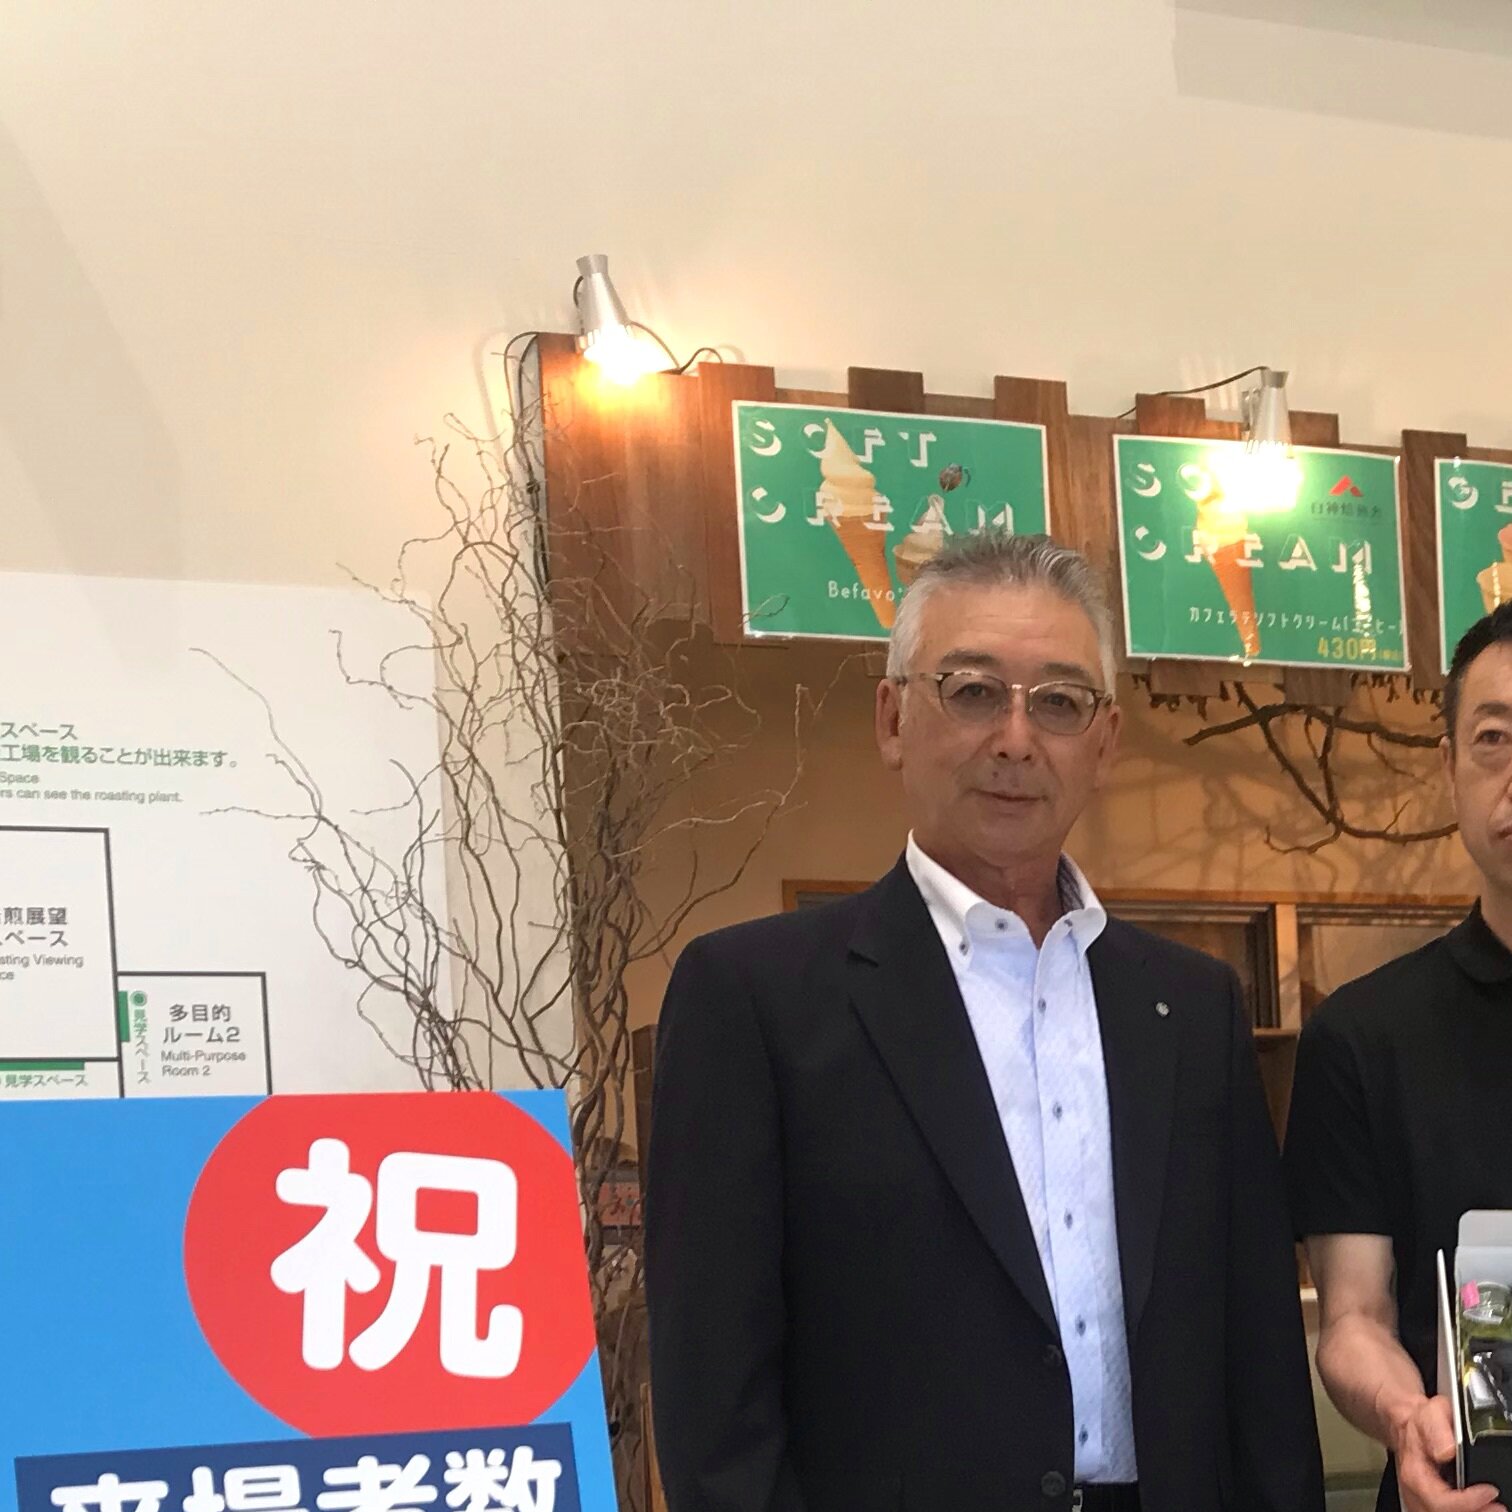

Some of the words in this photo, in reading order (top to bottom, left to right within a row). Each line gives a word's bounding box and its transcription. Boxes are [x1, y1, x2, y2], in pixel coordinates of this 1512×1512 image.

[1130, 525, 1372, 574] CREAM
[828, 579, 903, 602] Befavo
[0, 743, 237, 768] 工場を観ることが出来ます。
[0, 771, 39, 786] Space
[16, 788, 40, 799] can
[44, 789, 67, 800] see
[70, 788, 91, 800] the
[94, 789, 145, 804] roasting
[0, 906, 68, 925] 煎展望
[0, 929, 68, 947] ペース
[33, 953, 84, 968] Viewing
[169, 1004, 232, 1022] 多目的
[163, 1026, 241, 1044] ルーム2
[160, 1050, 247, 1063] Multi-Purpose
[162, 1065, 199, 1077] Room
[202, 1065, 211, 1077] 2
[270, 1138, 524, 1379] 祝
